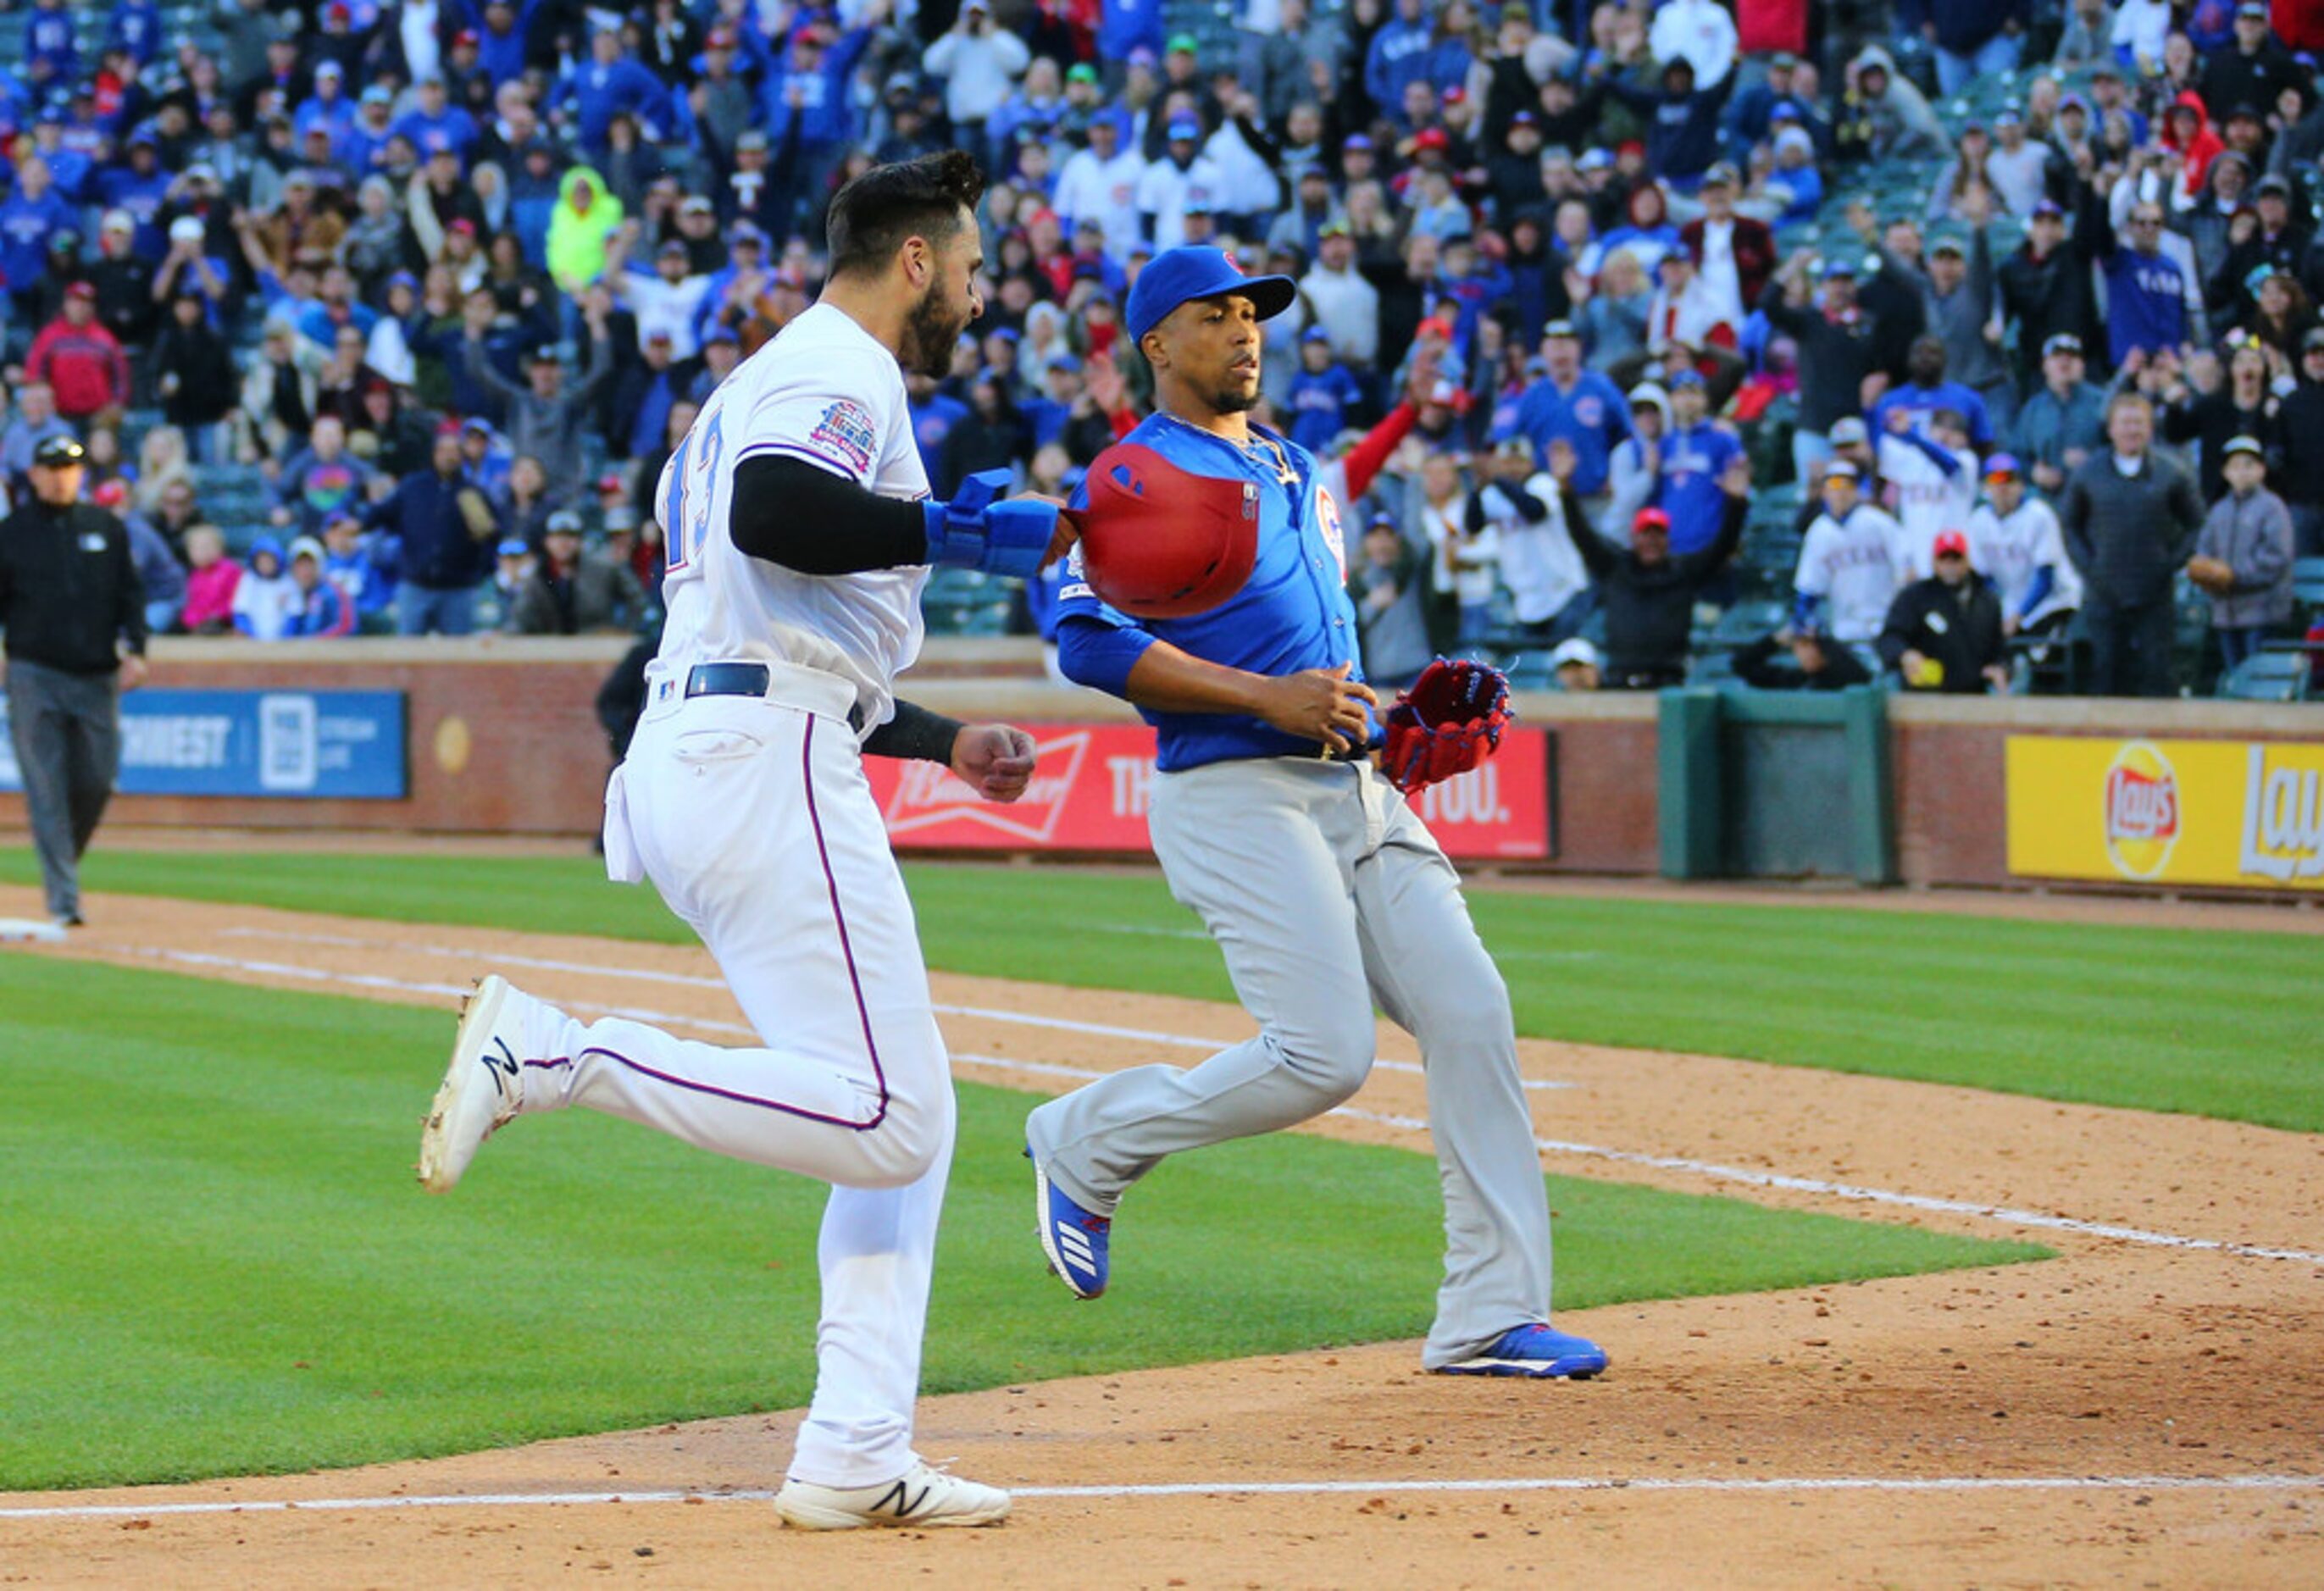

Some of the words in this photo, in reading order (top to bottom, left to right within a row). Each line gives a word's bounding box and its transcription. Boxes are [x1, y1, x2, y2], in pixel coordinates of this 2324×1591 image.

[118, 716, 232, 768] HWEST
[1107, 756, 1158, 817] TH
[2111, 770, 2173, 840] Lay's
